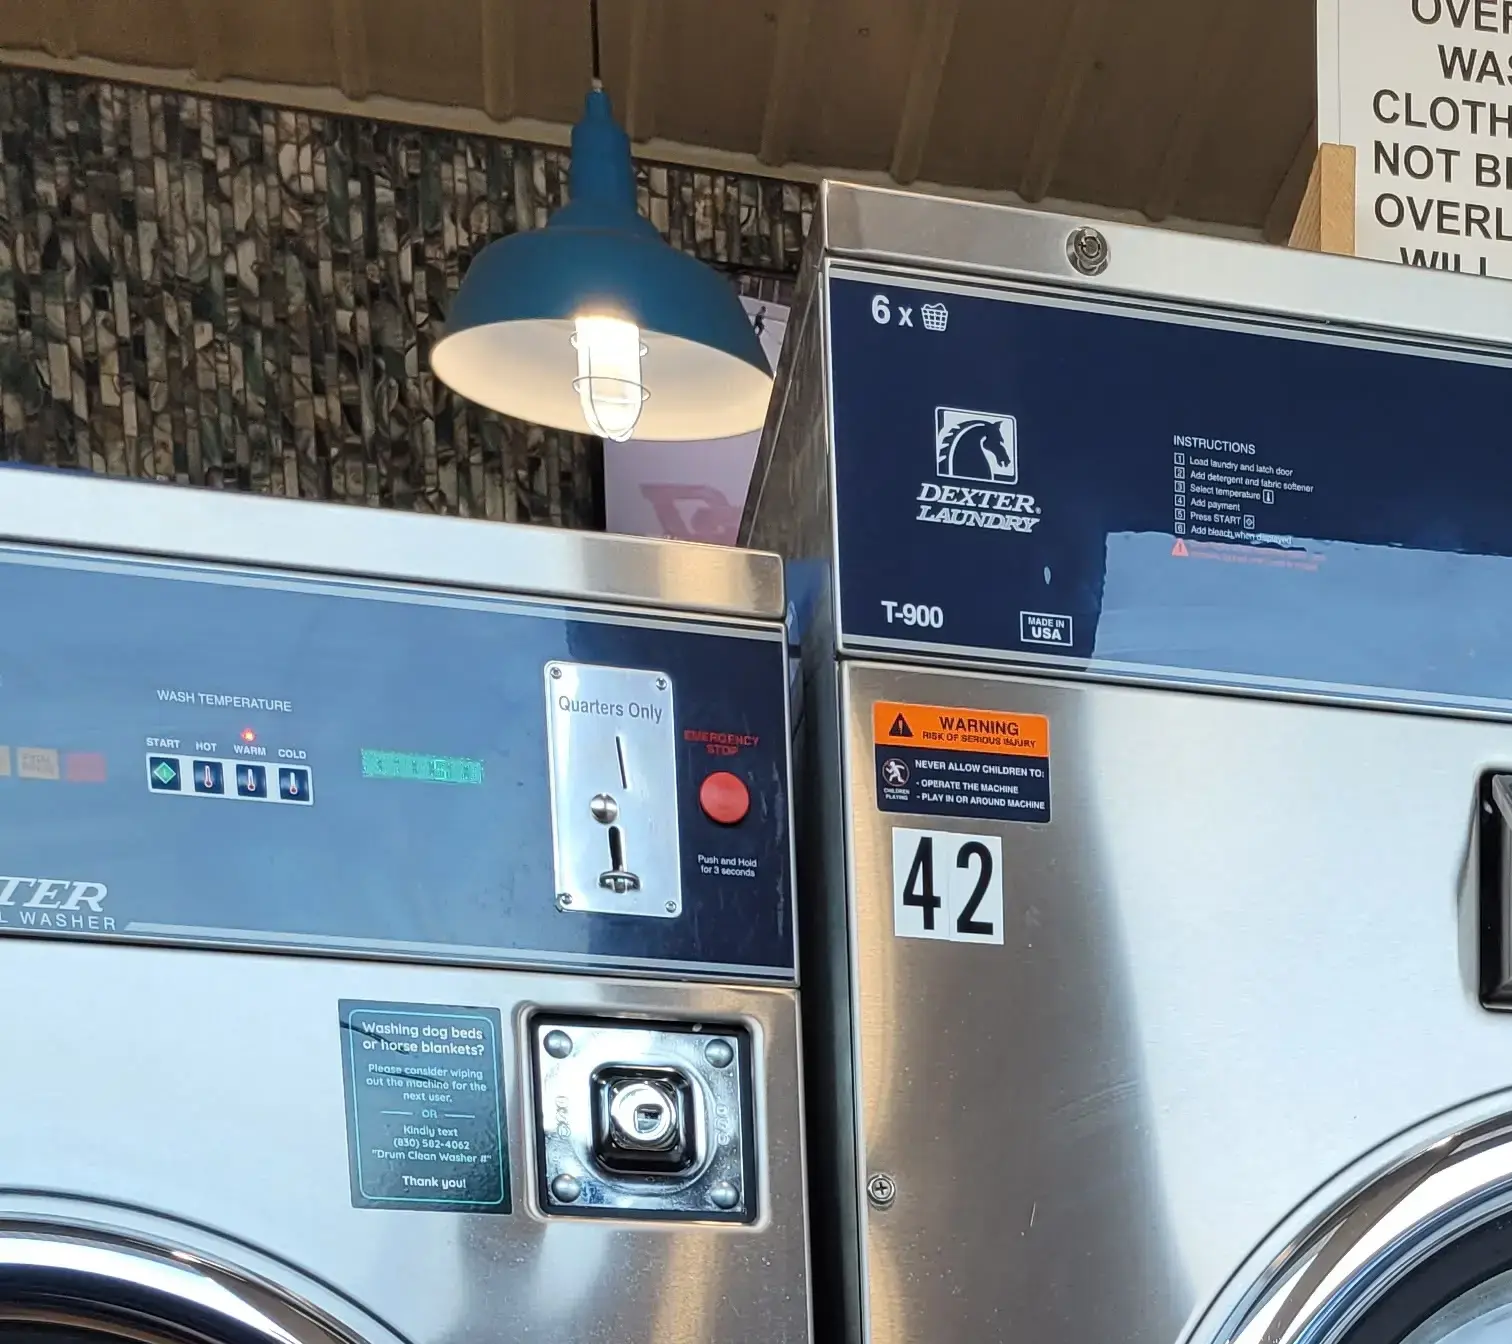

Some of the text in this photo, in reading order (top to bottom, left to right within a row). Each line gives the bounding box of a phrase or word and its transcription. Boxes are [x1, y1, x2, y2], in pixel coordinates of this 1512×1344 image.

[1374, 141, 1460, 183] NOT
[872, 295, 890, 325] 6
[1174, 435, 1256, 455] INSTRUCTIONS
[1190, 456, 1293, 476] Load laundry and latch door
[1191, 471, 1313, 492] Add detergent and fabric softener
[917, 483, 1037, 515] DEXTER
[1190, 484, 1261, 500] Select temperature
[1191, 499, 1240, 511] Add payment
[916, 505, 1039, 533] LAUNDRY
[1191, 511, 1241, 525] Press START
[881, 601, 943, 628] T-900
[1031, 626, 1062, 641] USA
[157, 689, 292, 712] WASH TEMPERATURE
[559, 696, 662, 724] Quarters Only
[939, 716, 1018, 735] WARNING
[146, 737, 180, 748] START
[196, 742, 217, 752] HOT
[923, 731, 1036, 748] RISK OF SERIOUS INJURY
[233, 744, 266, 755] WARM
[278, 749, 306, 759] COLD
[915, 760, 1044, 778] NEVER ALLOW CHILDREN TO:
[921, 780, 1018, 794] OPERATE THE MACHINE
[922, 793, 1045, 810] PLAY IN OR AROUND MACHINE
[698, 855, 757, 867] Push and Hold
[903, 837, 993, 935] 42
[20, 912, 116, 931] WASHER
[362, 1021, 483, 1041] Washing dog beds
[363, 1039, 484, 1056] or horse blankets?
[368, 1064, 482, 1081] Please consider wiping
[422, 1109, 437, 1119] OR
[404, 1125, 458, 1138] Kindly text
[402, 1175, 466, 1189] Thank you!
